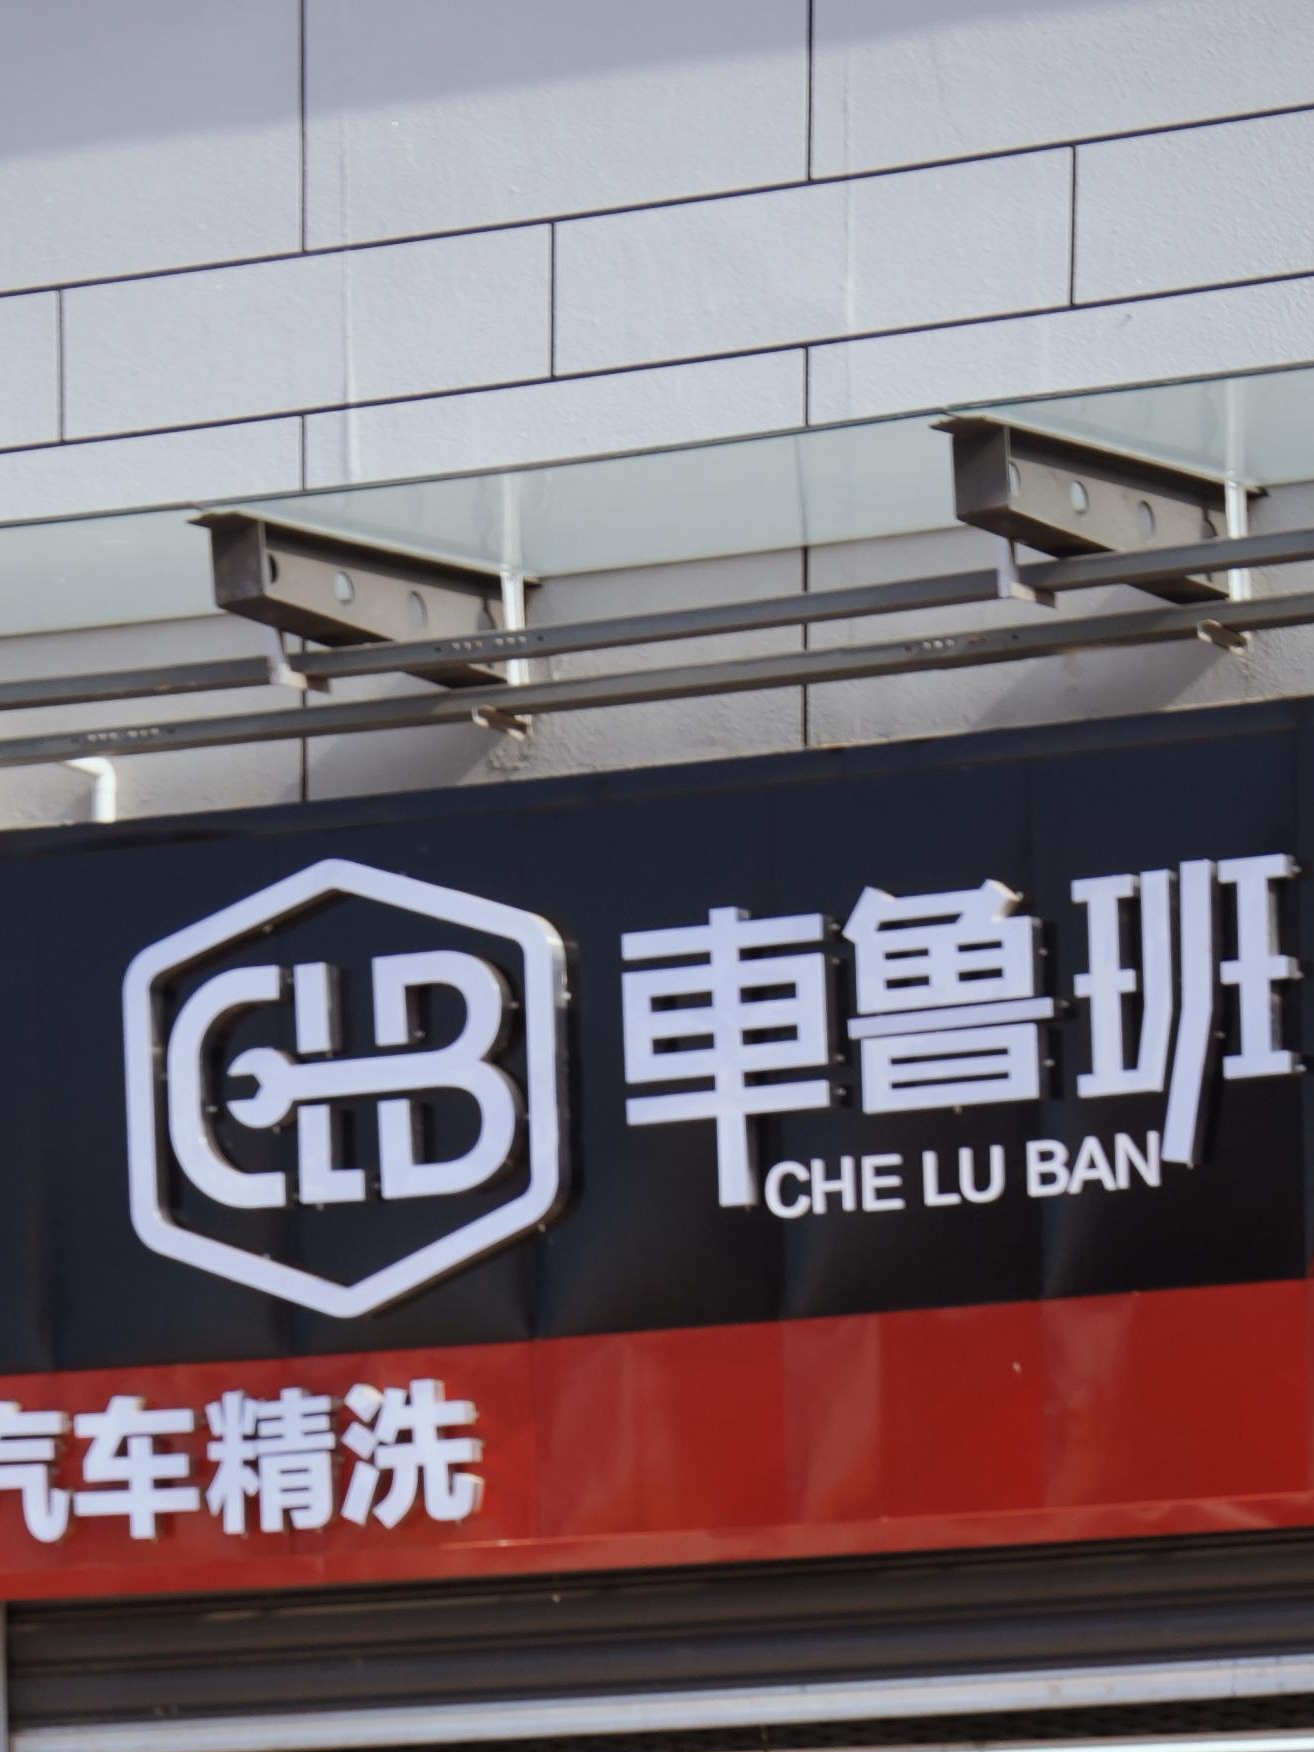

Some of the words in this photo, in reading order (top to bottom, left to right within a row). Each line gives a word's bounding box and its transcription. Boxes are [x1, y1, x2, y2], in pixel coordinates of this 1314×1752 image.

[765, 1154, 905, 1218] CHE
[922, 1144, 1004, 1206] LU
[1026, 1130, 1161, 1197] BAN
